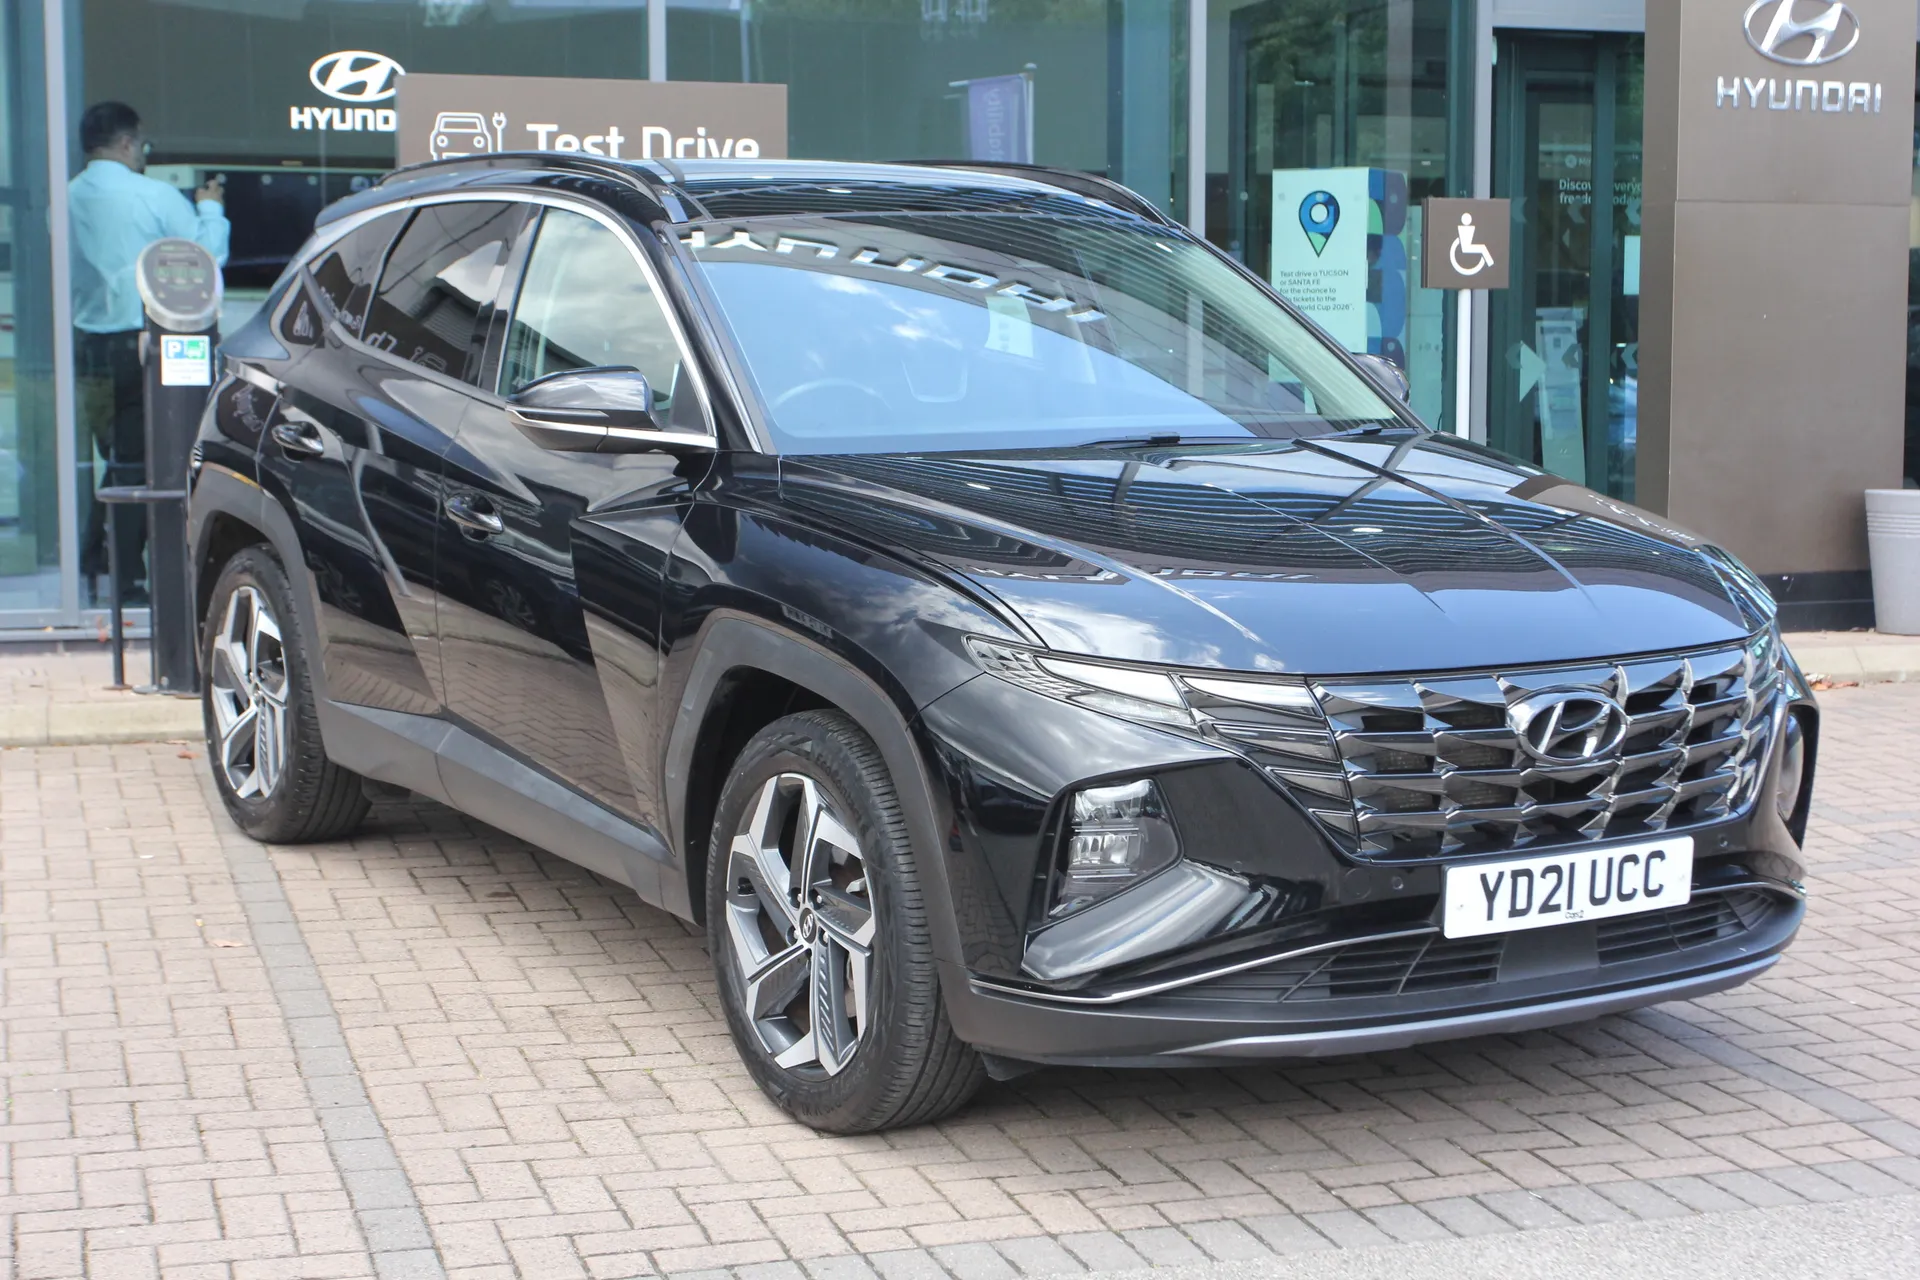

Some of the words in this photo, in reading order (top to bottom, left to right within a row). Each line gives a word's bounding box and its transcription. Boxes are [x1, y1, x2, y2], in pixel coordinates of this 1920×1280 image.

[1716, 76, 1882, 113] HYUNDAI
[290, 106, 397, 132] HYUND
[526, 123, 625, 158] Test
[642, 126, 760, 158] Drive
[1480, 862, 1576, 921] YD21
[1590, 850, 1666, 906] UCC
